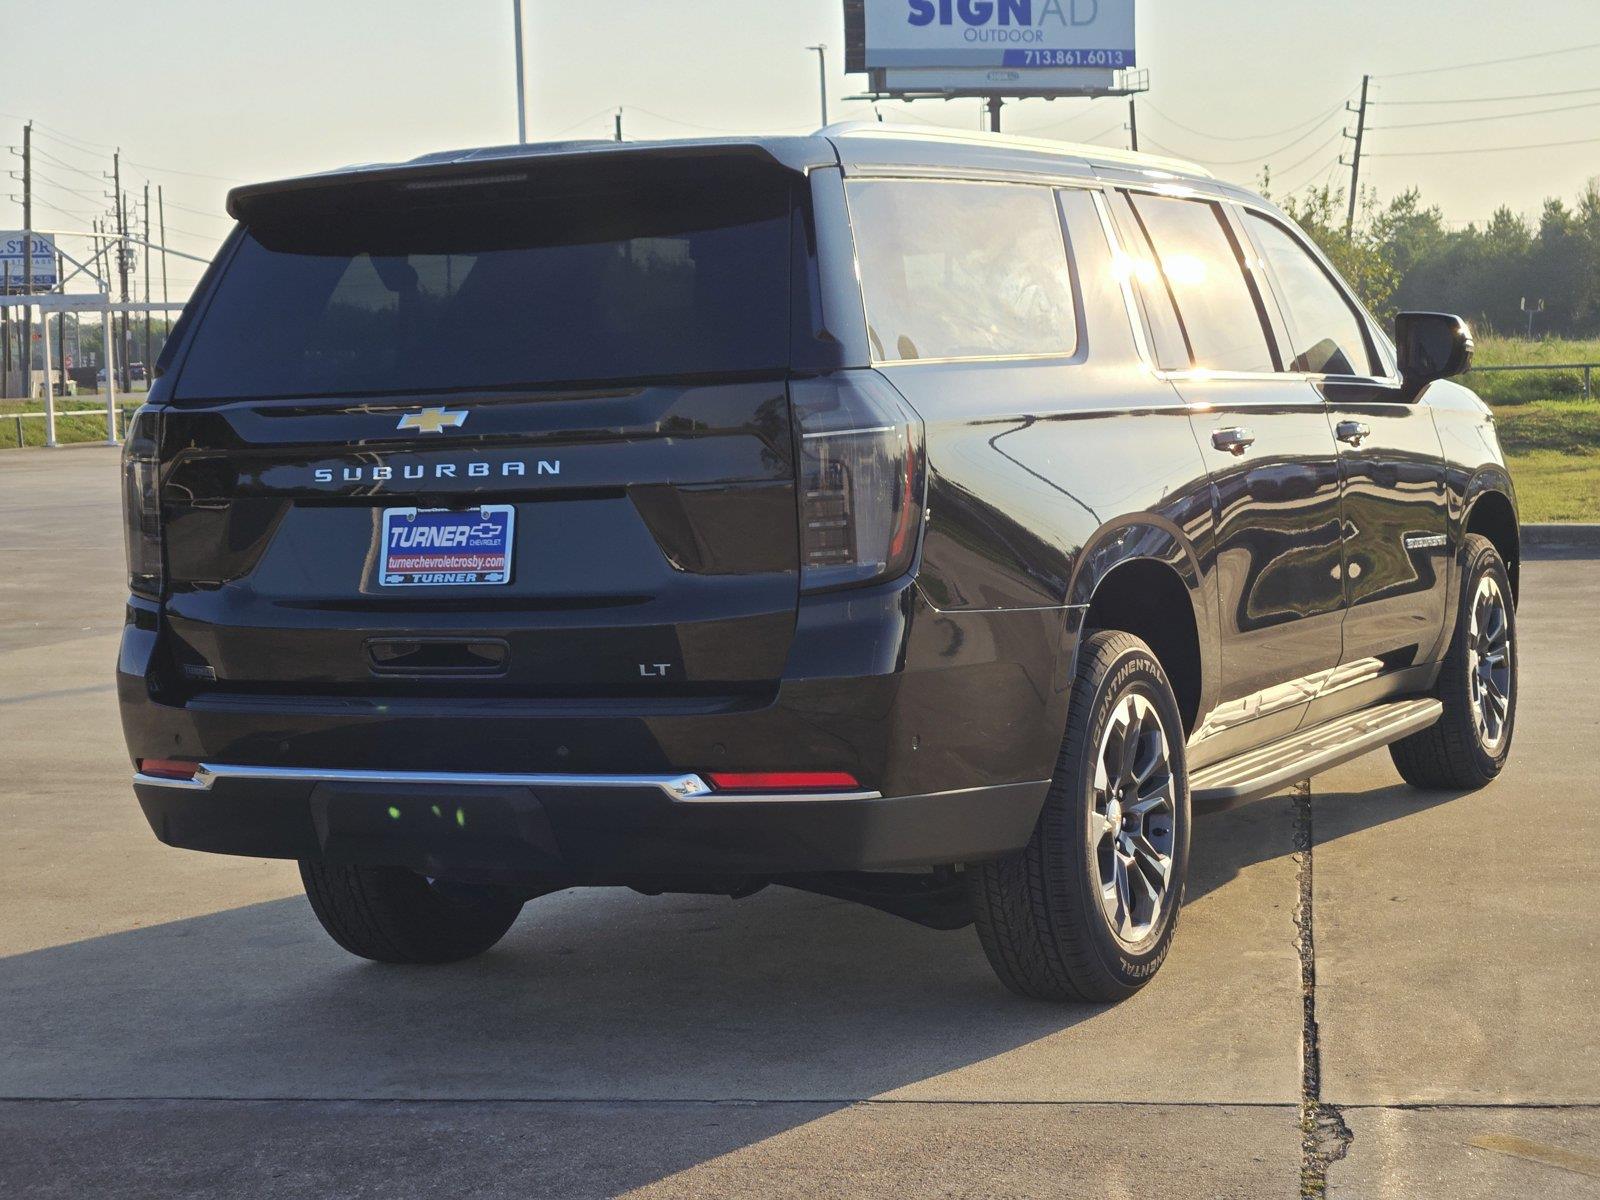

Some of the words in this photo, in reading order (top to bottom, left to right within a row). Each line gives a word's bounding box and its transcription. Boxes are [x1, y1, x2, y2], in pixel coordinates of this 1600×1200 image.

[963, 28, 1043, 43] OUTDOOR
[1024, 50, 1124, 65] 713.861.6013
[314, 460, 561, 482] SUBURBAN
[390, 525, 471, 548] TURNER
[469, 538, 501, 546] CHEVROLET
[388, 554, 505, 570] turnerchevroletcrosby.com
[411, 573, 477, 583] TURNER
[639, 663, 671, 676] LT
[1092, 658, 1163, 749] CONTINENTAL
